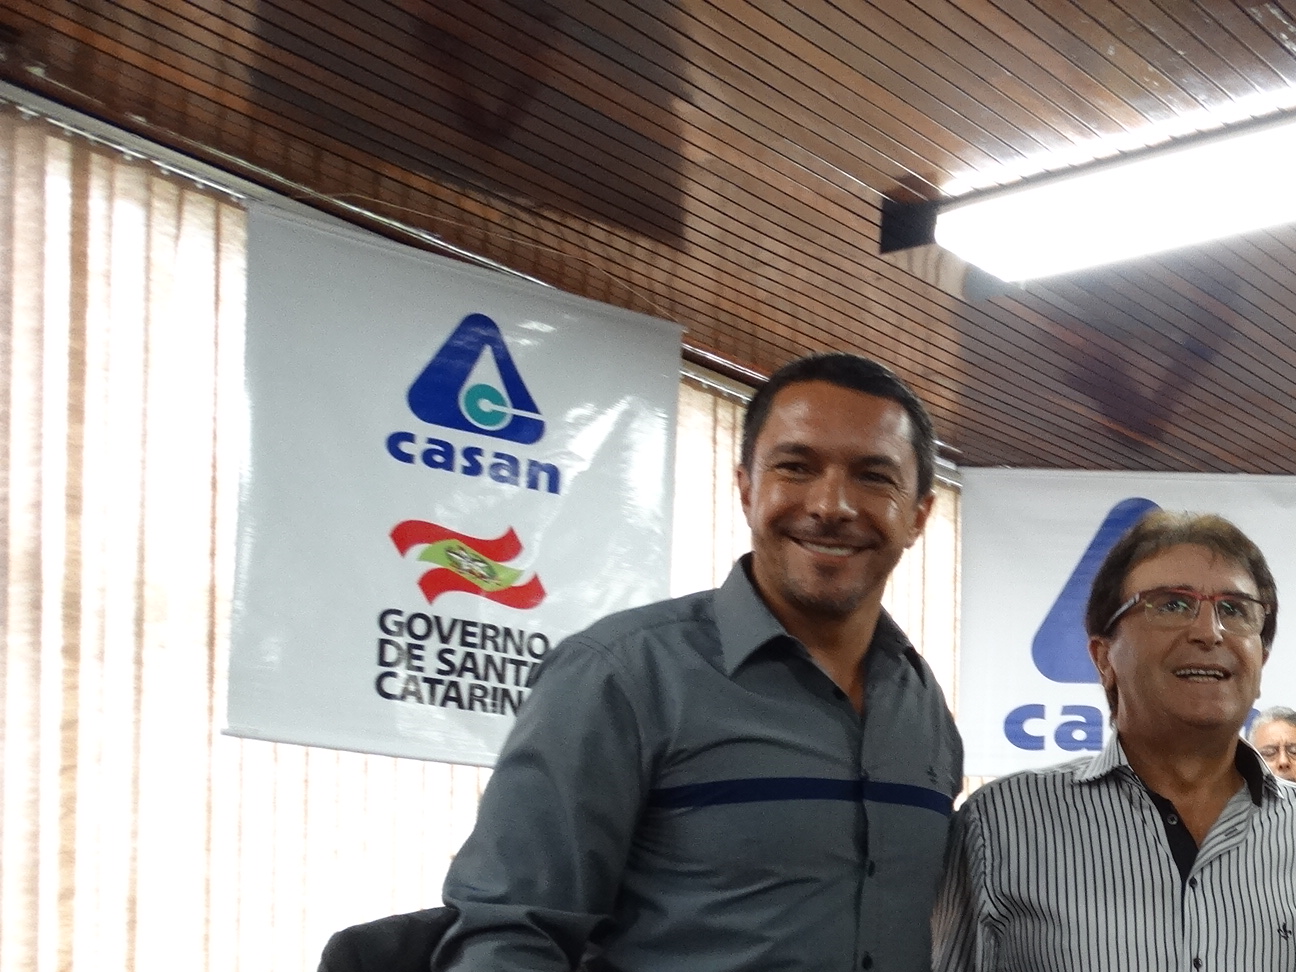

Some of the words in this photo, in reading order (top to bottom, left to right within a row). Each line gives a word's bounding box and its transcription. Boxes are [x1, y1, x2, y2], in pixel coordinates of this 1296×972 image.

[386, 430, 561, 495] casan
[377, 638, 425, 672] DE
[378, 608, 549, 660] GOVERNO
[375, 671, 524, 717] CATARIN
